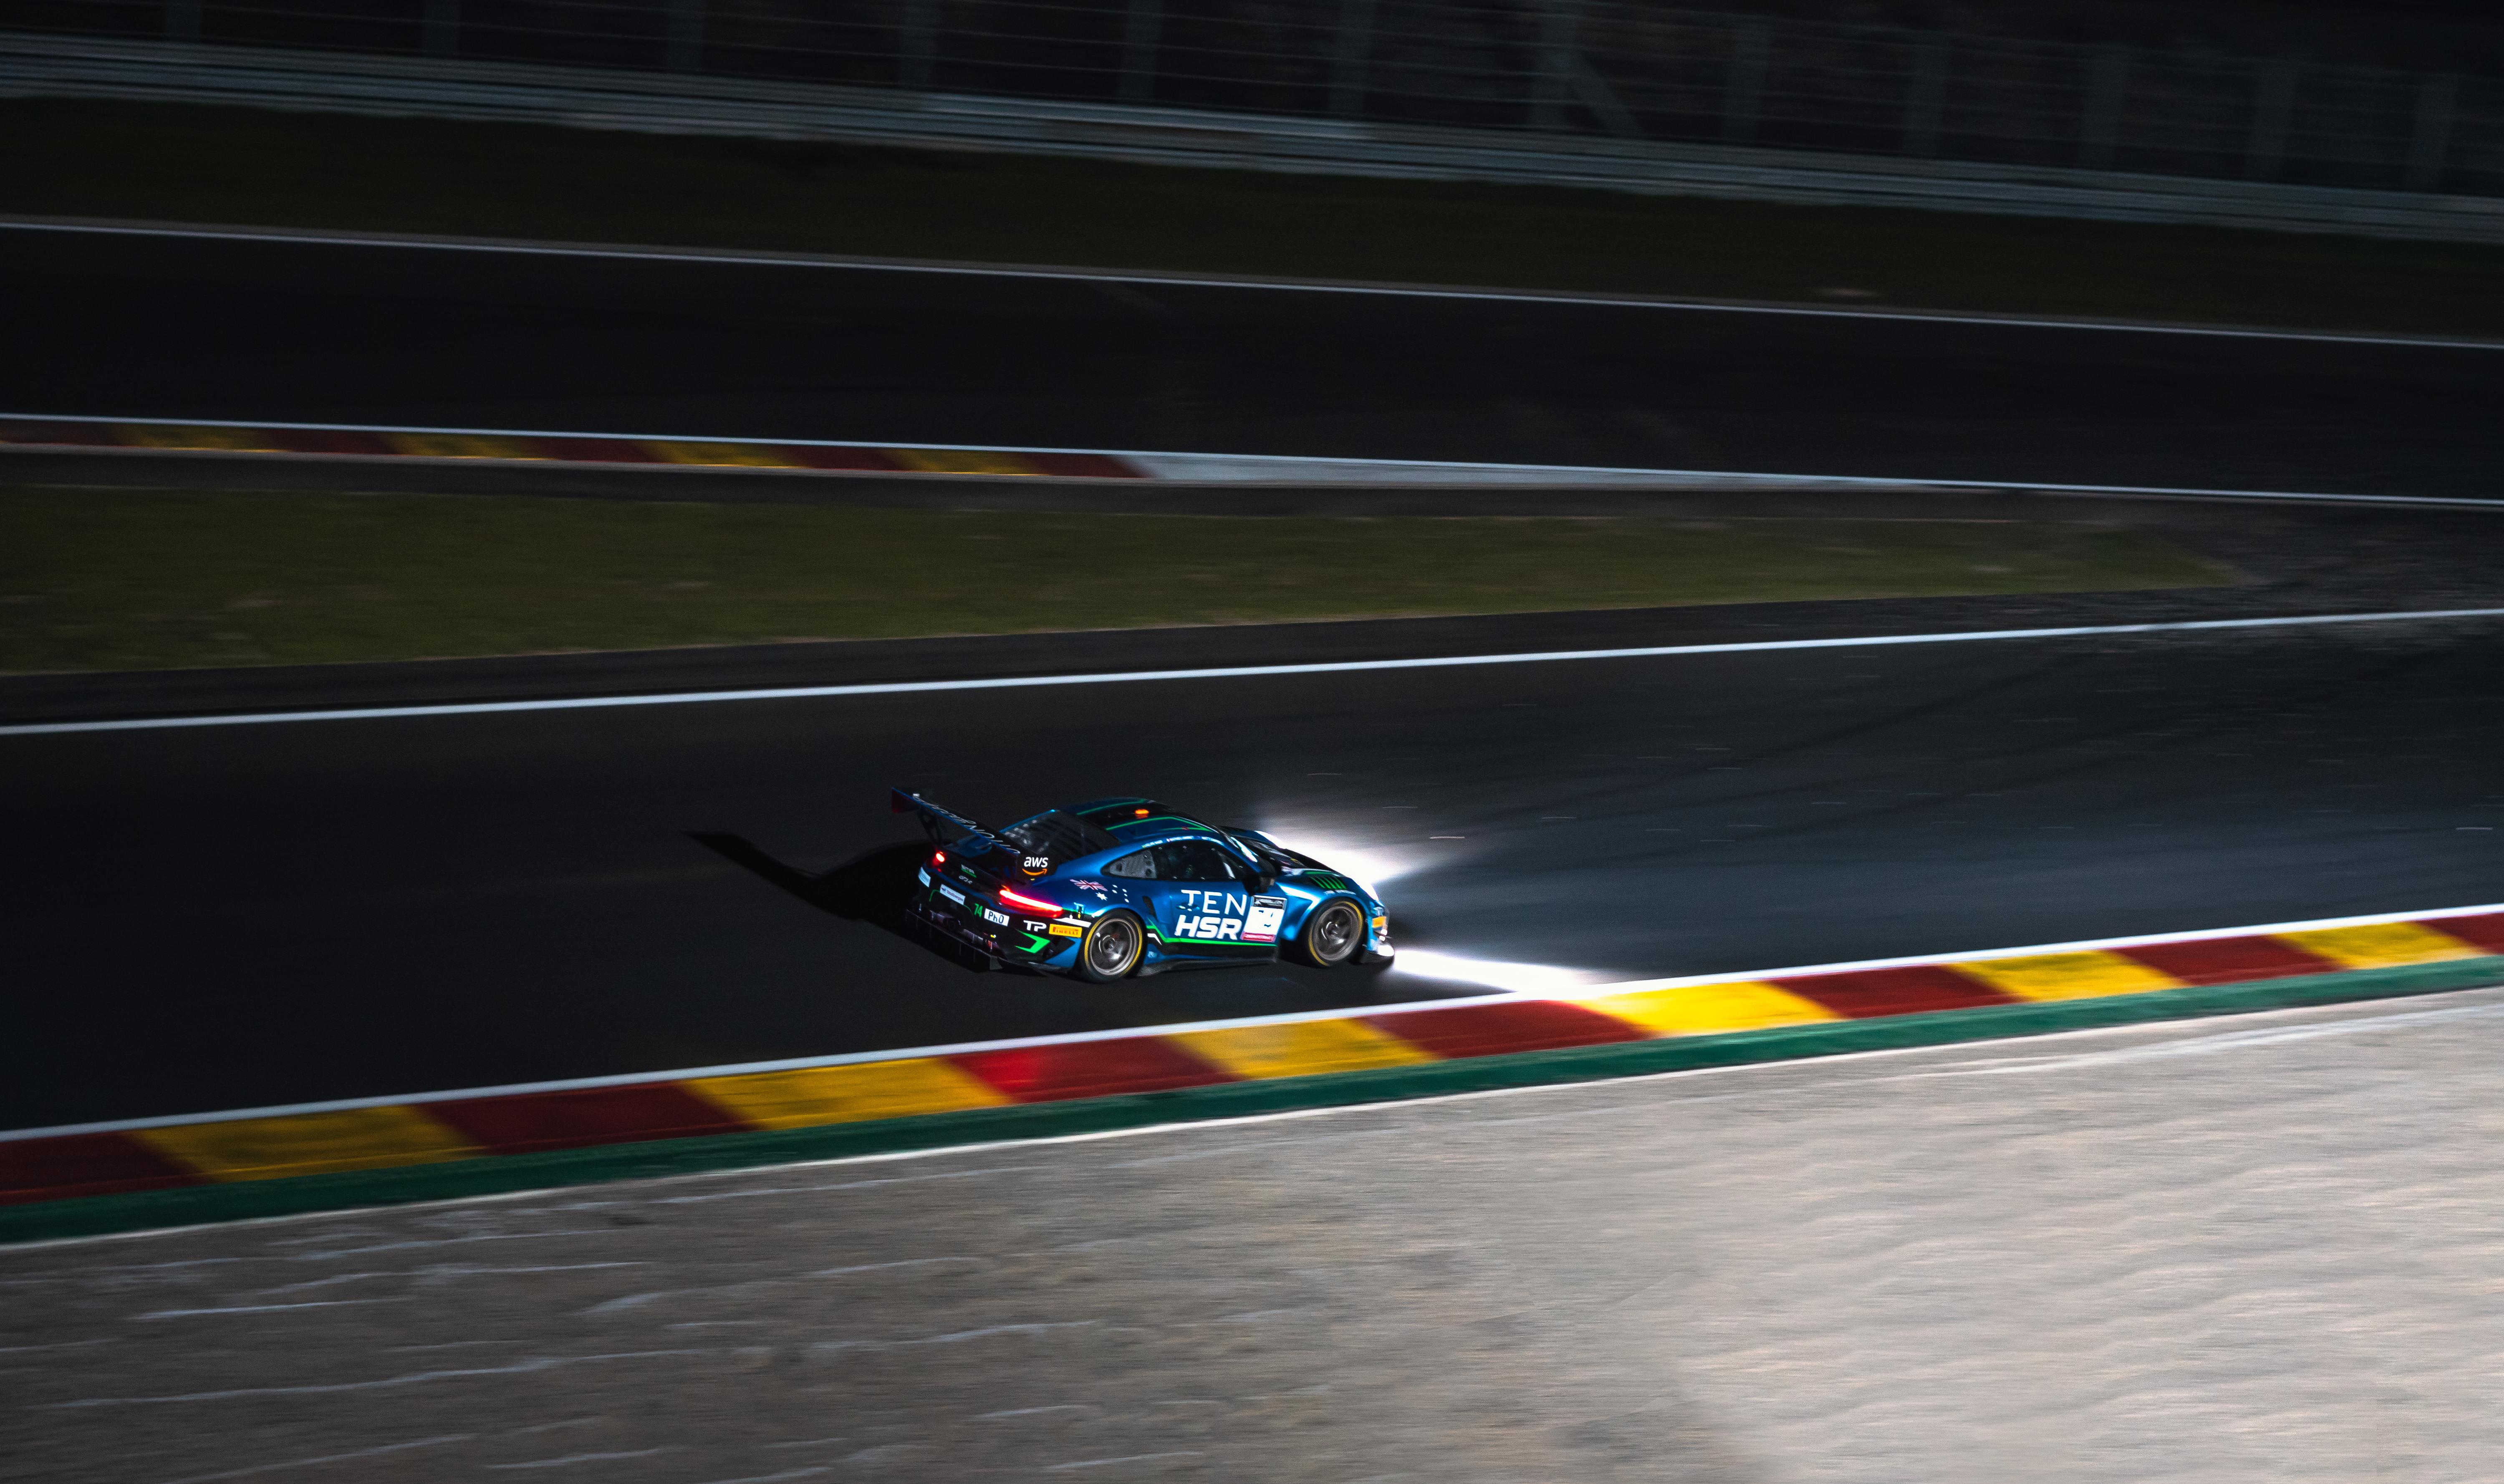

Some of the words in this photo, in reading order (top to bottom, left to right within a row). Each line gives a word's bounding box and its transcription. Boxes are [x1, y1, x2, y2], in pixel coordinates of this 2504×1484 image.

[1024, 856, 1048, 868] aws
[1181, 889, 1247, 916] TEN
[973, 903, 984, 919] 74
[1023, 920, 1047, 932] TP
[1174, 914, 1242, 940] HSR
